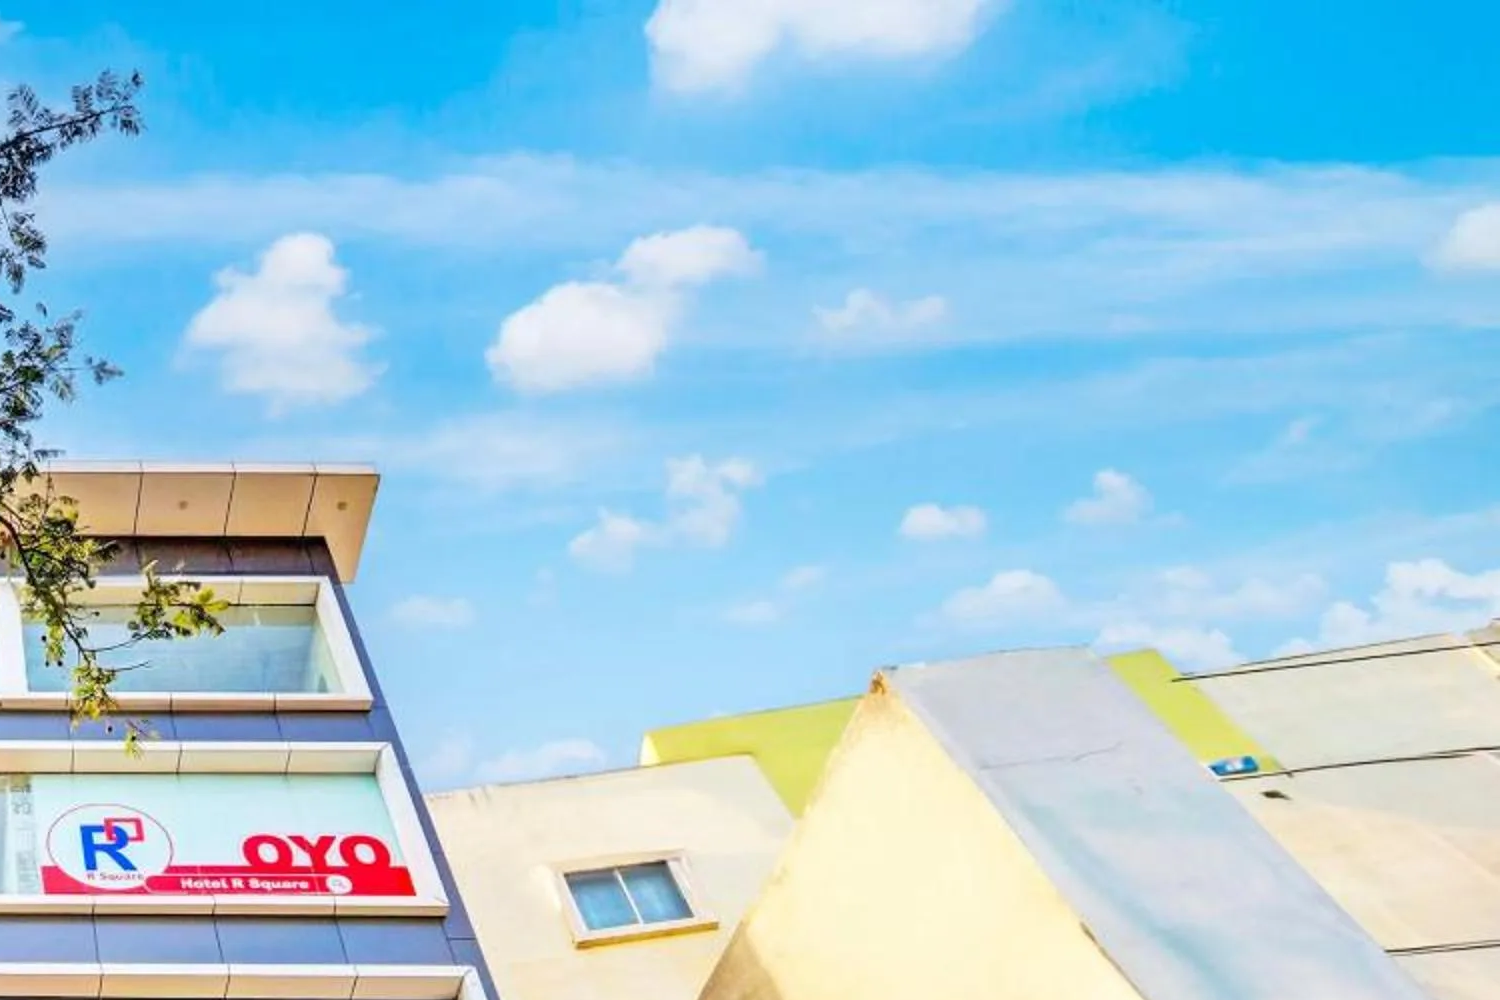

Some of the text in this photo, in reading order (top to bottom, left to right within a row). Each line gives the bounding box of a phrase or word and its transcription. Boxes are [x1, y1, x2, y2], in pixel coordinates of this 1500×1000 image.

[242, 834, 391, 872] OYO
[180, 877, 309, 893] Hotel R Square
